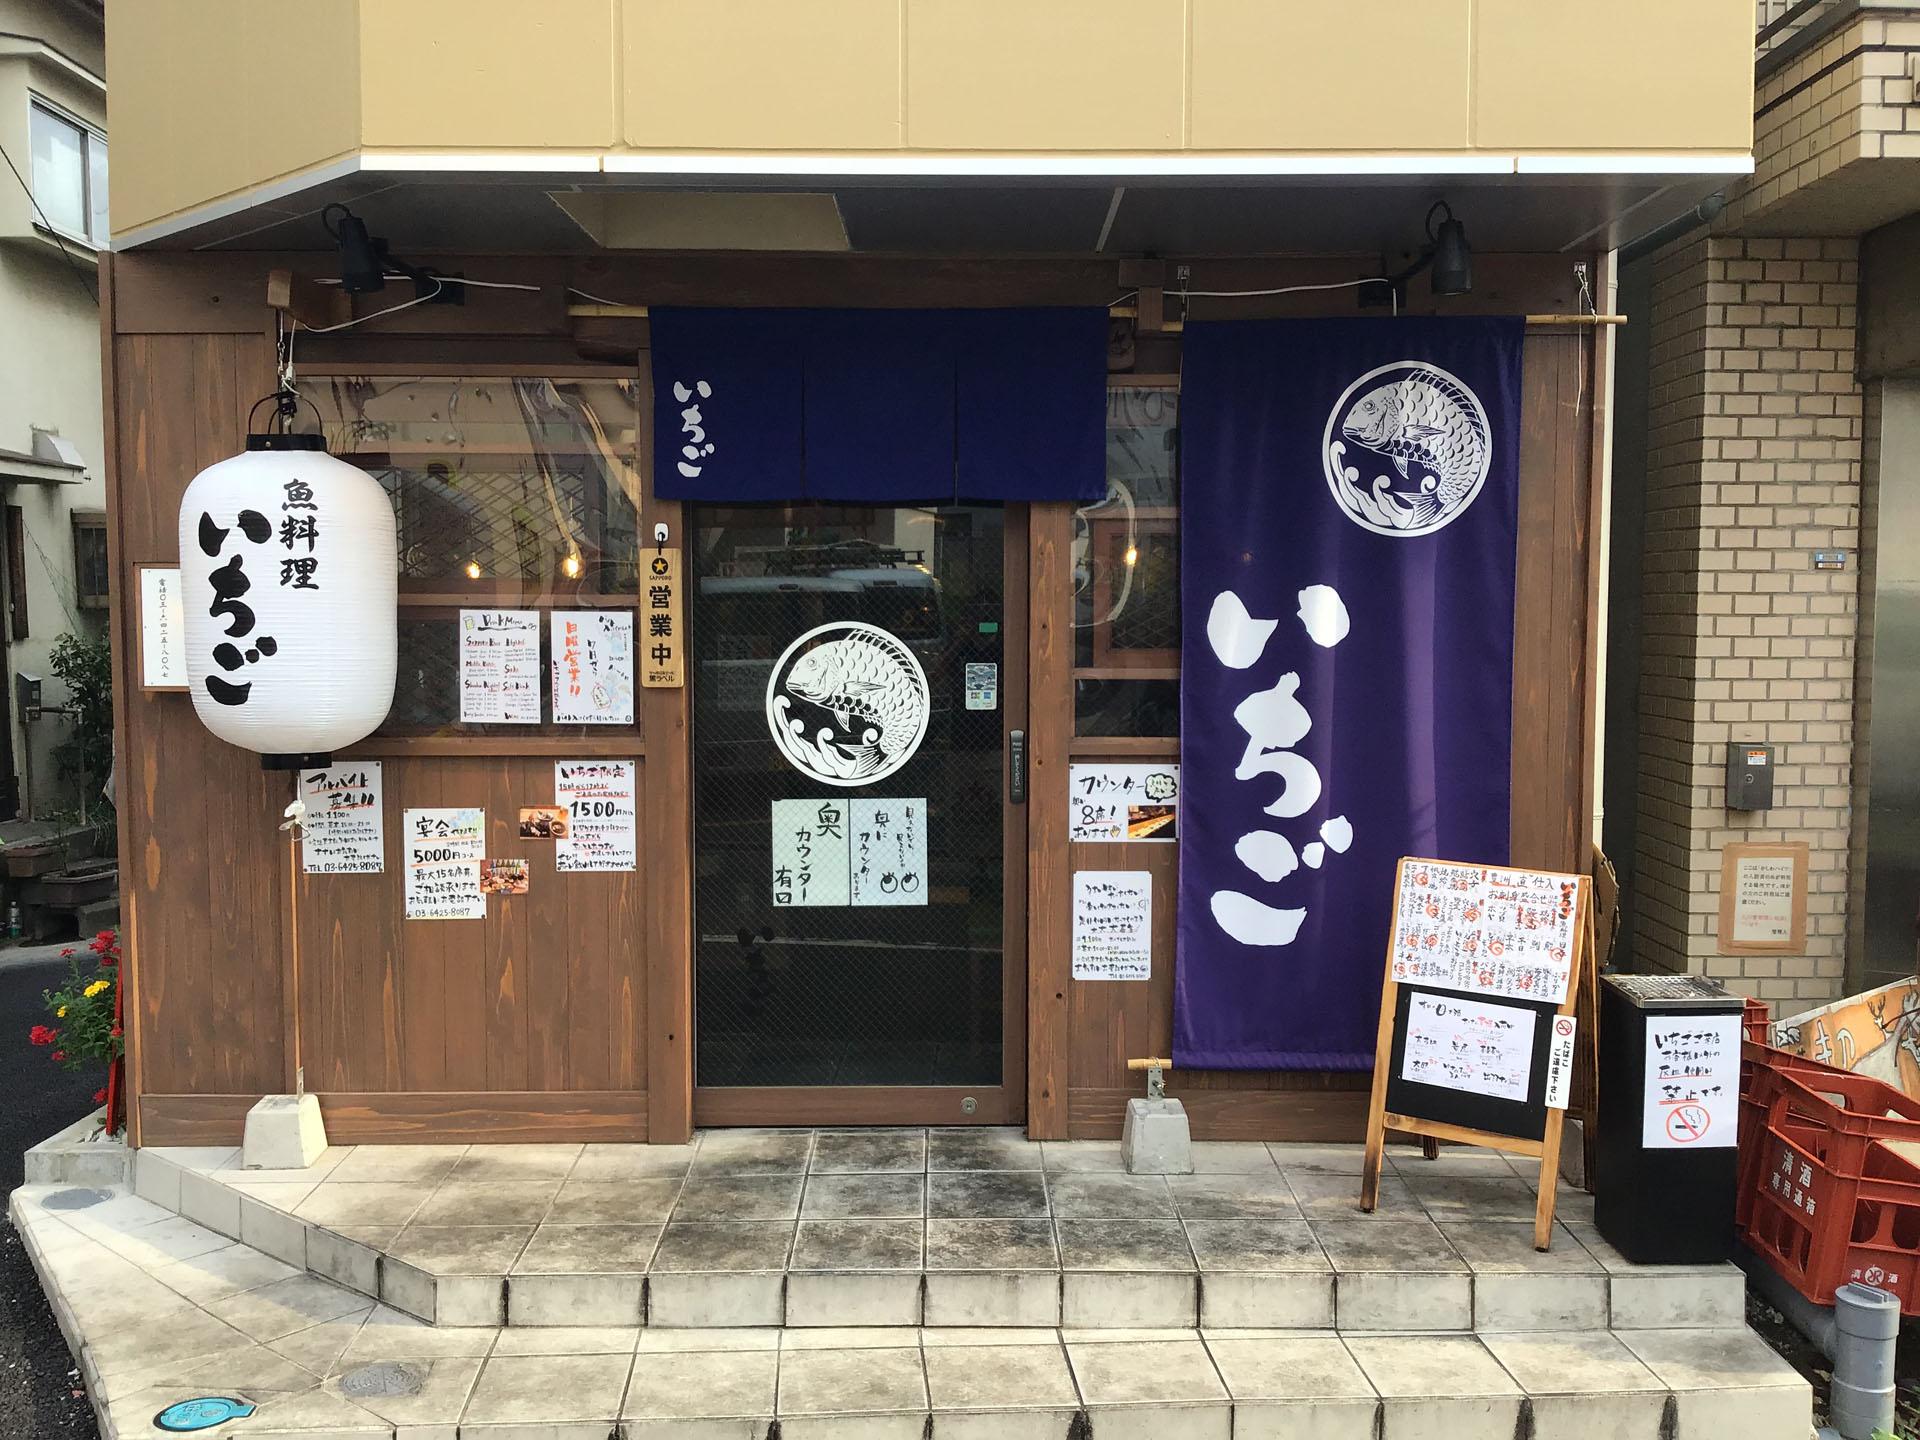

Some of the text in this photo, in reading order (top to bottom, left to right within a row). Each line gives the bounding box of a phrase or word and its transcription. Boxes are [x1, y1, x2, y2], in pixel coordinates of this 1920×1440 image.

[672, 380, 715, 478] いちご
[279, 478, 320, 590] 魚料理
[197, 509, 278, 706] いちご
[649, 585, 673, 666] 営業中
[306, 772, 369, 791] アルバイト
[1078, 774, 1145, 795] カウンター
[1206, 583, 1354, 947] いちご
[816, 802, 842, 839] 奥
[795, 826, 813, 902] カウンター
[859, 832, 871, 884] カウンター
[1549, 1048, 1561, 1102] ご遠慮下さい
[1562, 1040, 1571, 1067] たばこ
[1771, 1171, 1817, 1217] 専用通箱
[1781, 1148, 1813, 1189] 清酒
